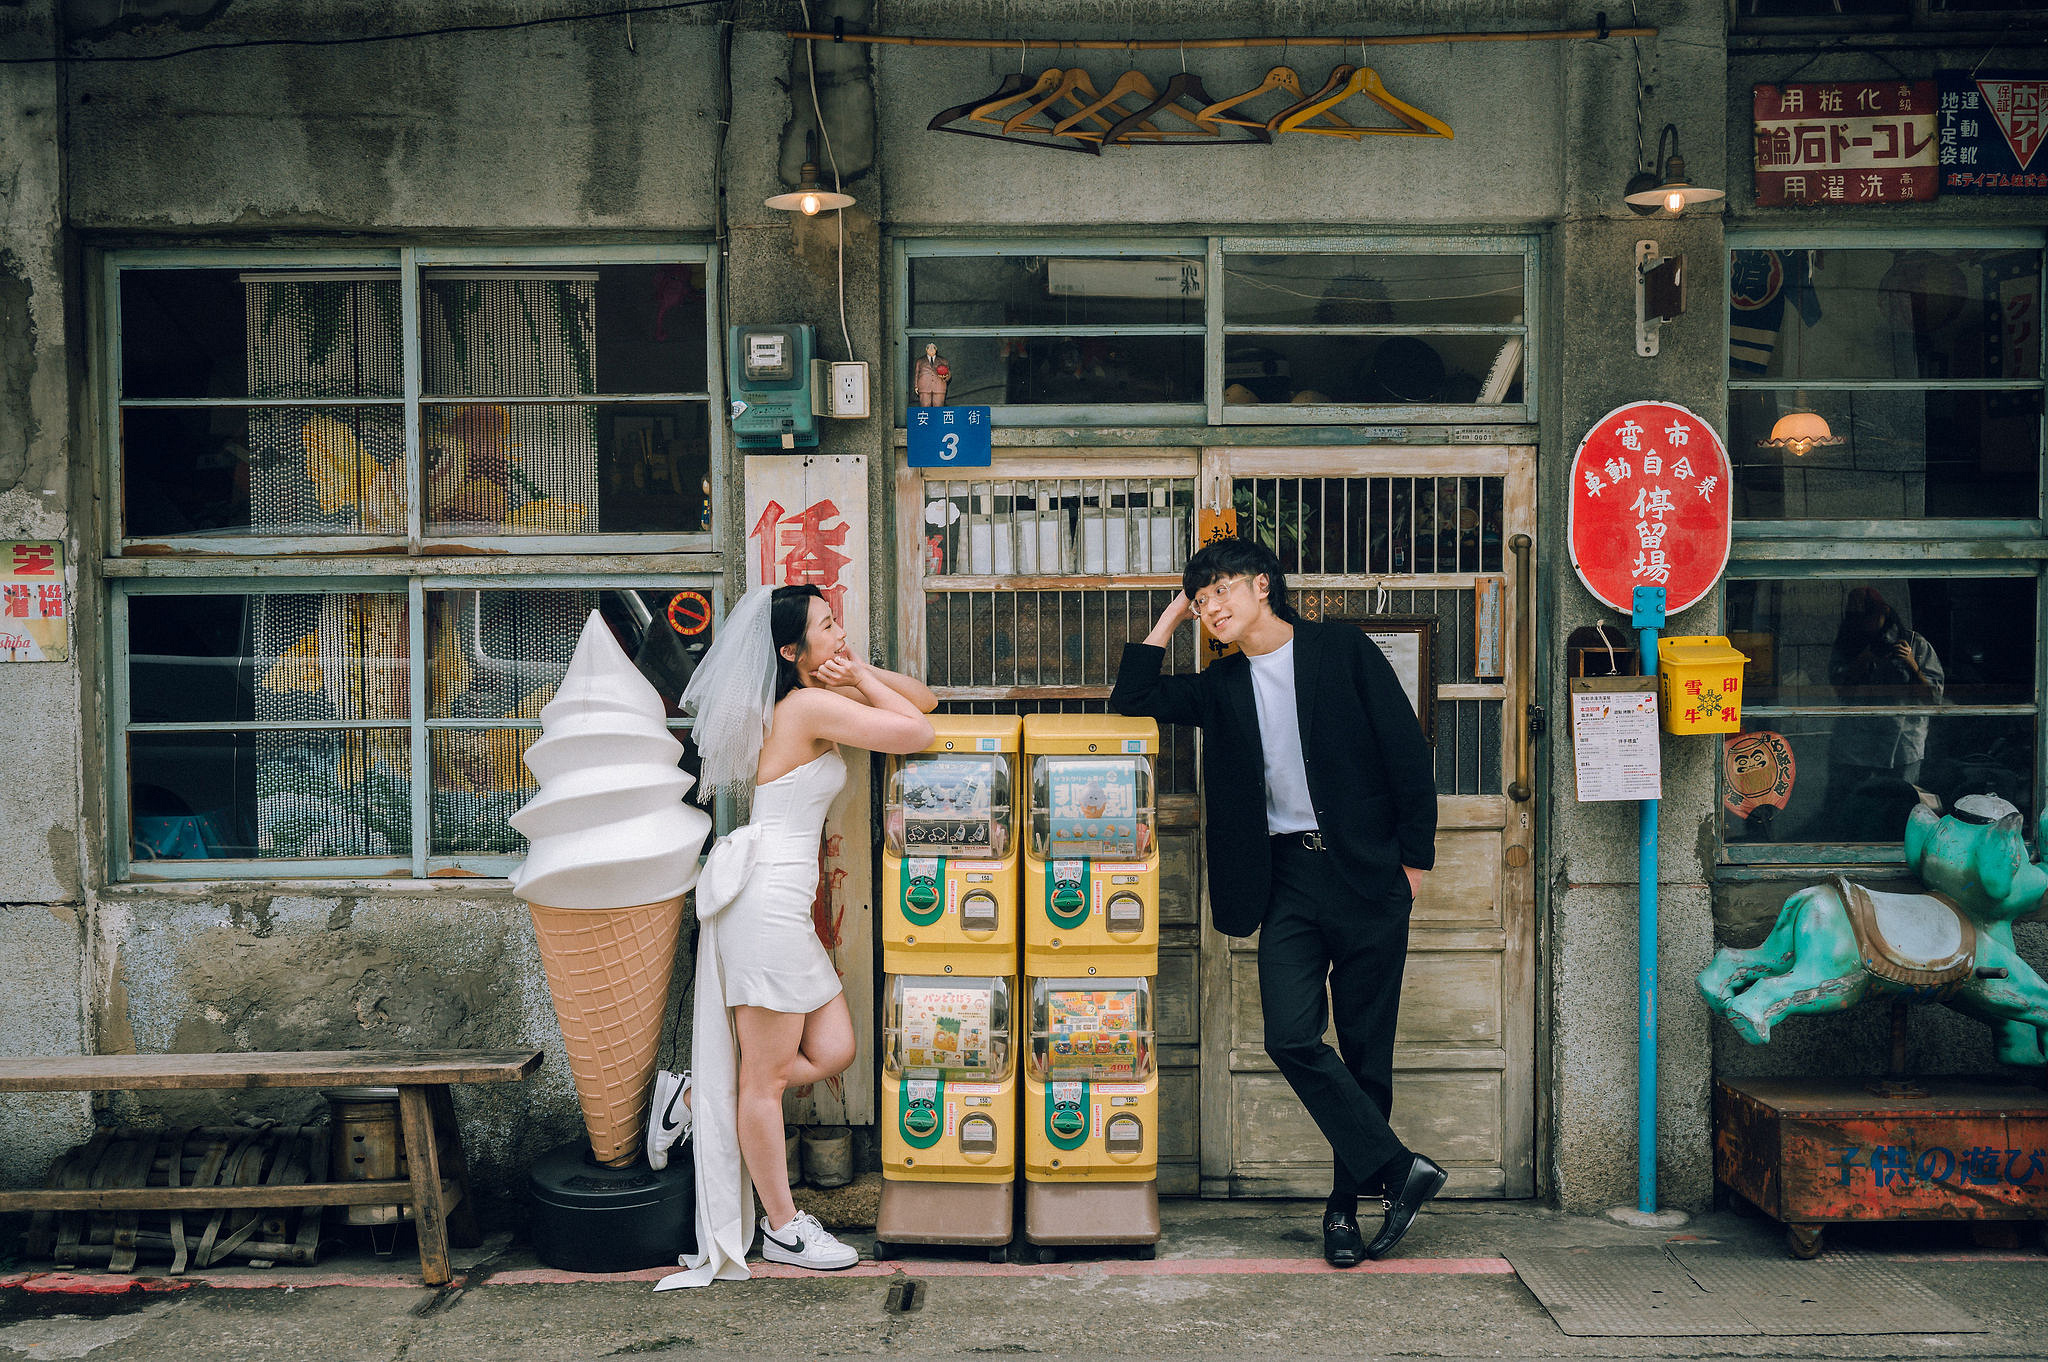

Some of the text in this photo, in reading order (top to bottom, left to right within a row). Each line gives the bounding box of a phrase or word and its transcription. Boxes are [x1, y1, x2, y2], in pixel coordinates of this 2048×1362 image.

[1940, 91, 1959, 165] 地下足袋
[1960, 91, 1980, 165] 運動靴
[2011, 84, 2038, 153] ホテイ
[916, 409, 981, 426] 安西街
[939, 433, 960, 461] 3
[12, 544, 55, 575] 芝
[1629, 484, 1676, 585] 停留場
[1825, 1145, 2048, 1187] 子供の遊び
